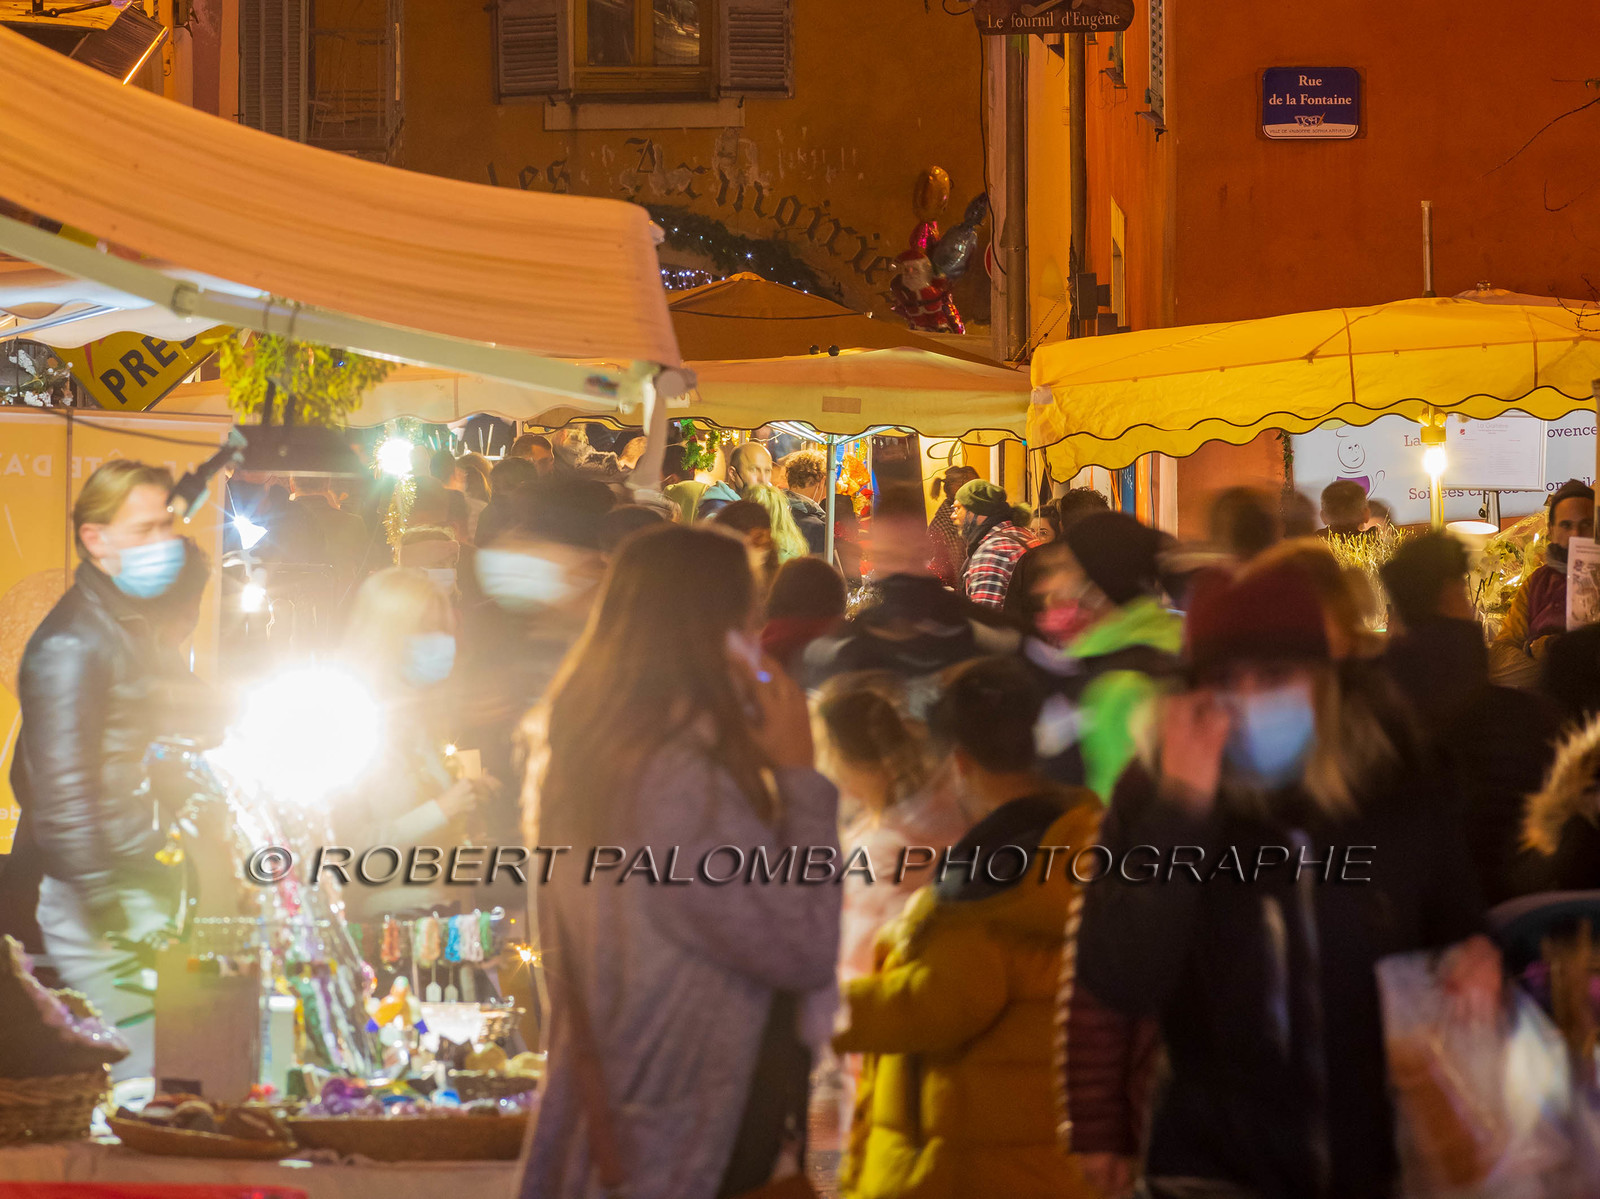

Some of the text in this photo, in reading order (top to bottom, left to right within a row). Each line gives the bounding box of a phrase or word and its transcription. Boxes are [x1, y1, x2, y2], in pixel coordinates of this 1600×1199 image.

[987, 11, 1120, 31] Le fournil d'Eugène
[1299, 74, 1322, 87] Rue
[1268, 92, 1352, 106] de la Fontaine
[1547, 424, 1597, 438] ovence
